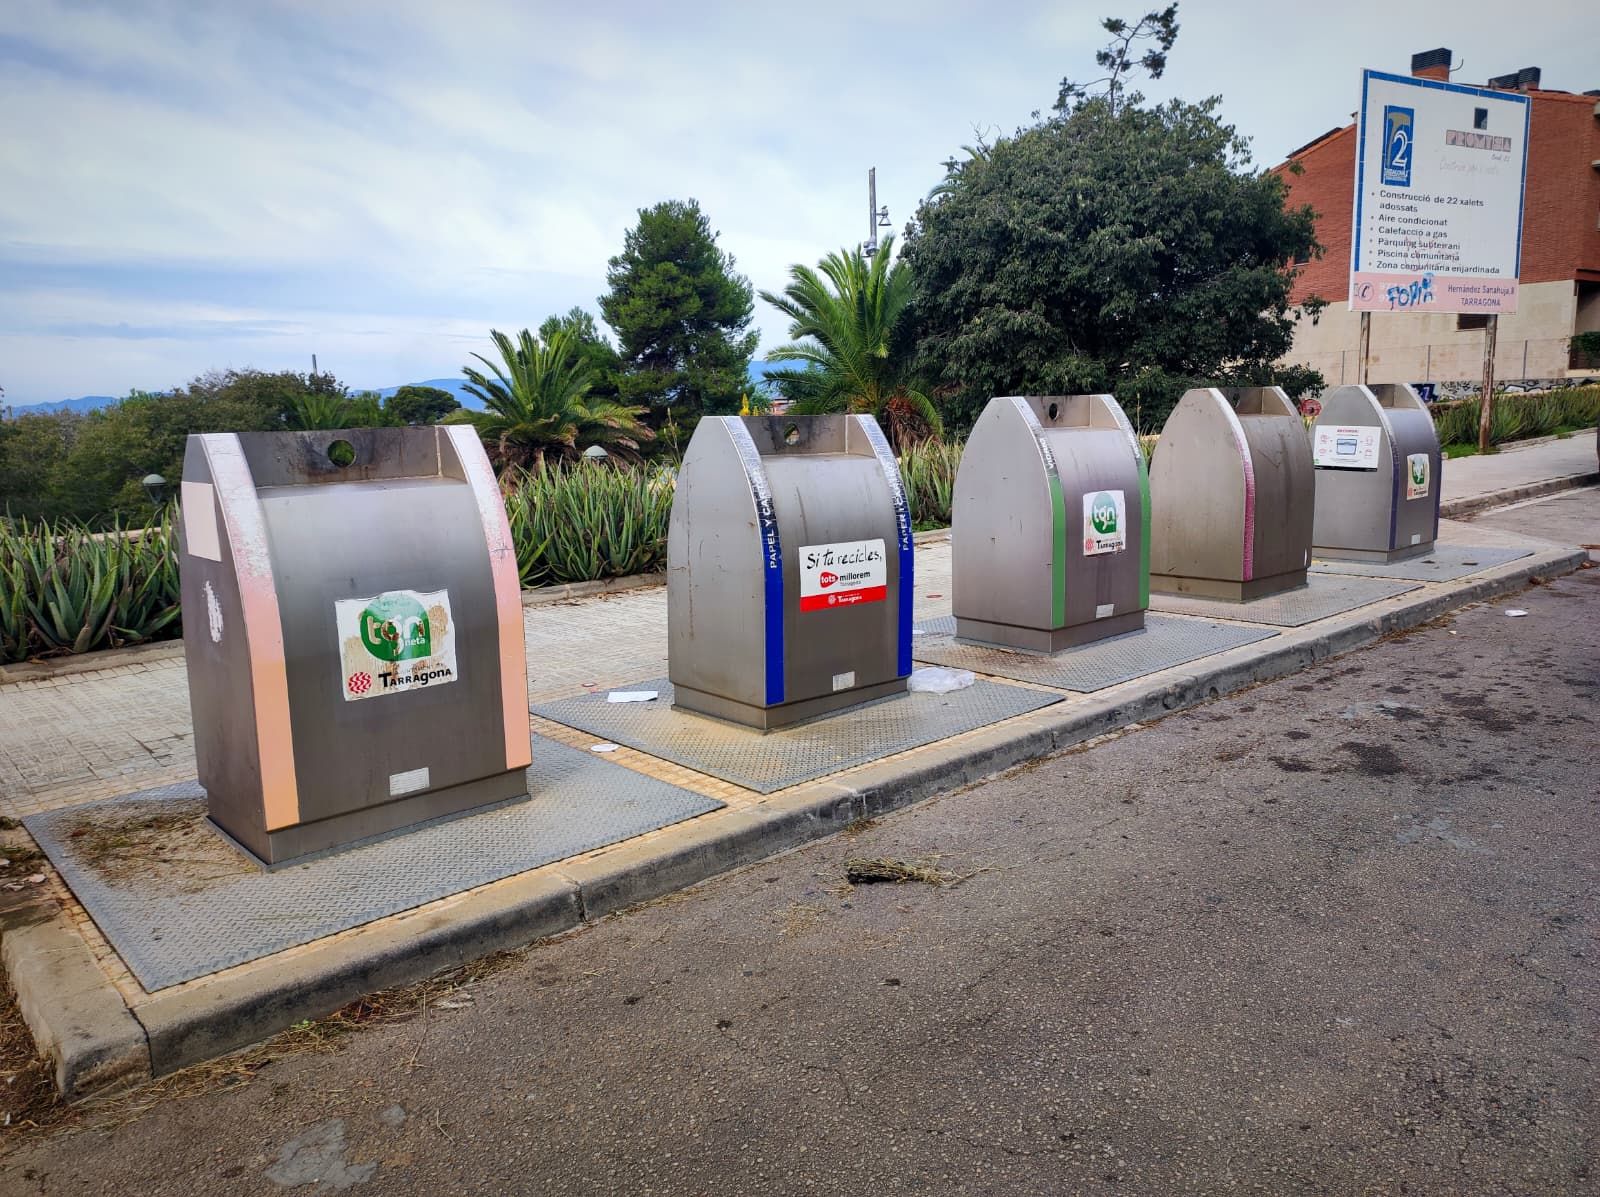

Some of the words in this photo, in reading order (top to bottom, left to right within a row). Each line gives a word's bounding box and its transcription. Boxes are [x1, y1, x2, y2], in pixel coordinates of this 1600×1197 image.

[1380, 190, 1430, 203] Construcció
[1434, 196, 1445, 204] de
[1447, 197, 1458, 205] 22
[1460, 199, 1484, 207] xalets
[1379, 203, 1418, 212] adossats
[1378, 214, 1396, 222] Aire
[1398, 216, 1448, 226] condicionat
[1432, 231, 1448, 239] gas
[1377, 249, 1409, 258] Piscina
[1376, 260, 1398, 269] Zona
[1451, 264, 1500, 274] enjardinada
[1460, 297, 1501, 307] TARRAGONA
[764, 518, 774, 527] Y
[900, 513, 909, 550] PAPER
[767, 529, 777, 568] PAPEL
[806, 552, 821, 569] Si
[822, 548, 834, 566] tu
[821, 574, 836, 584] tots
[839, 571, 871, 582] millorem
